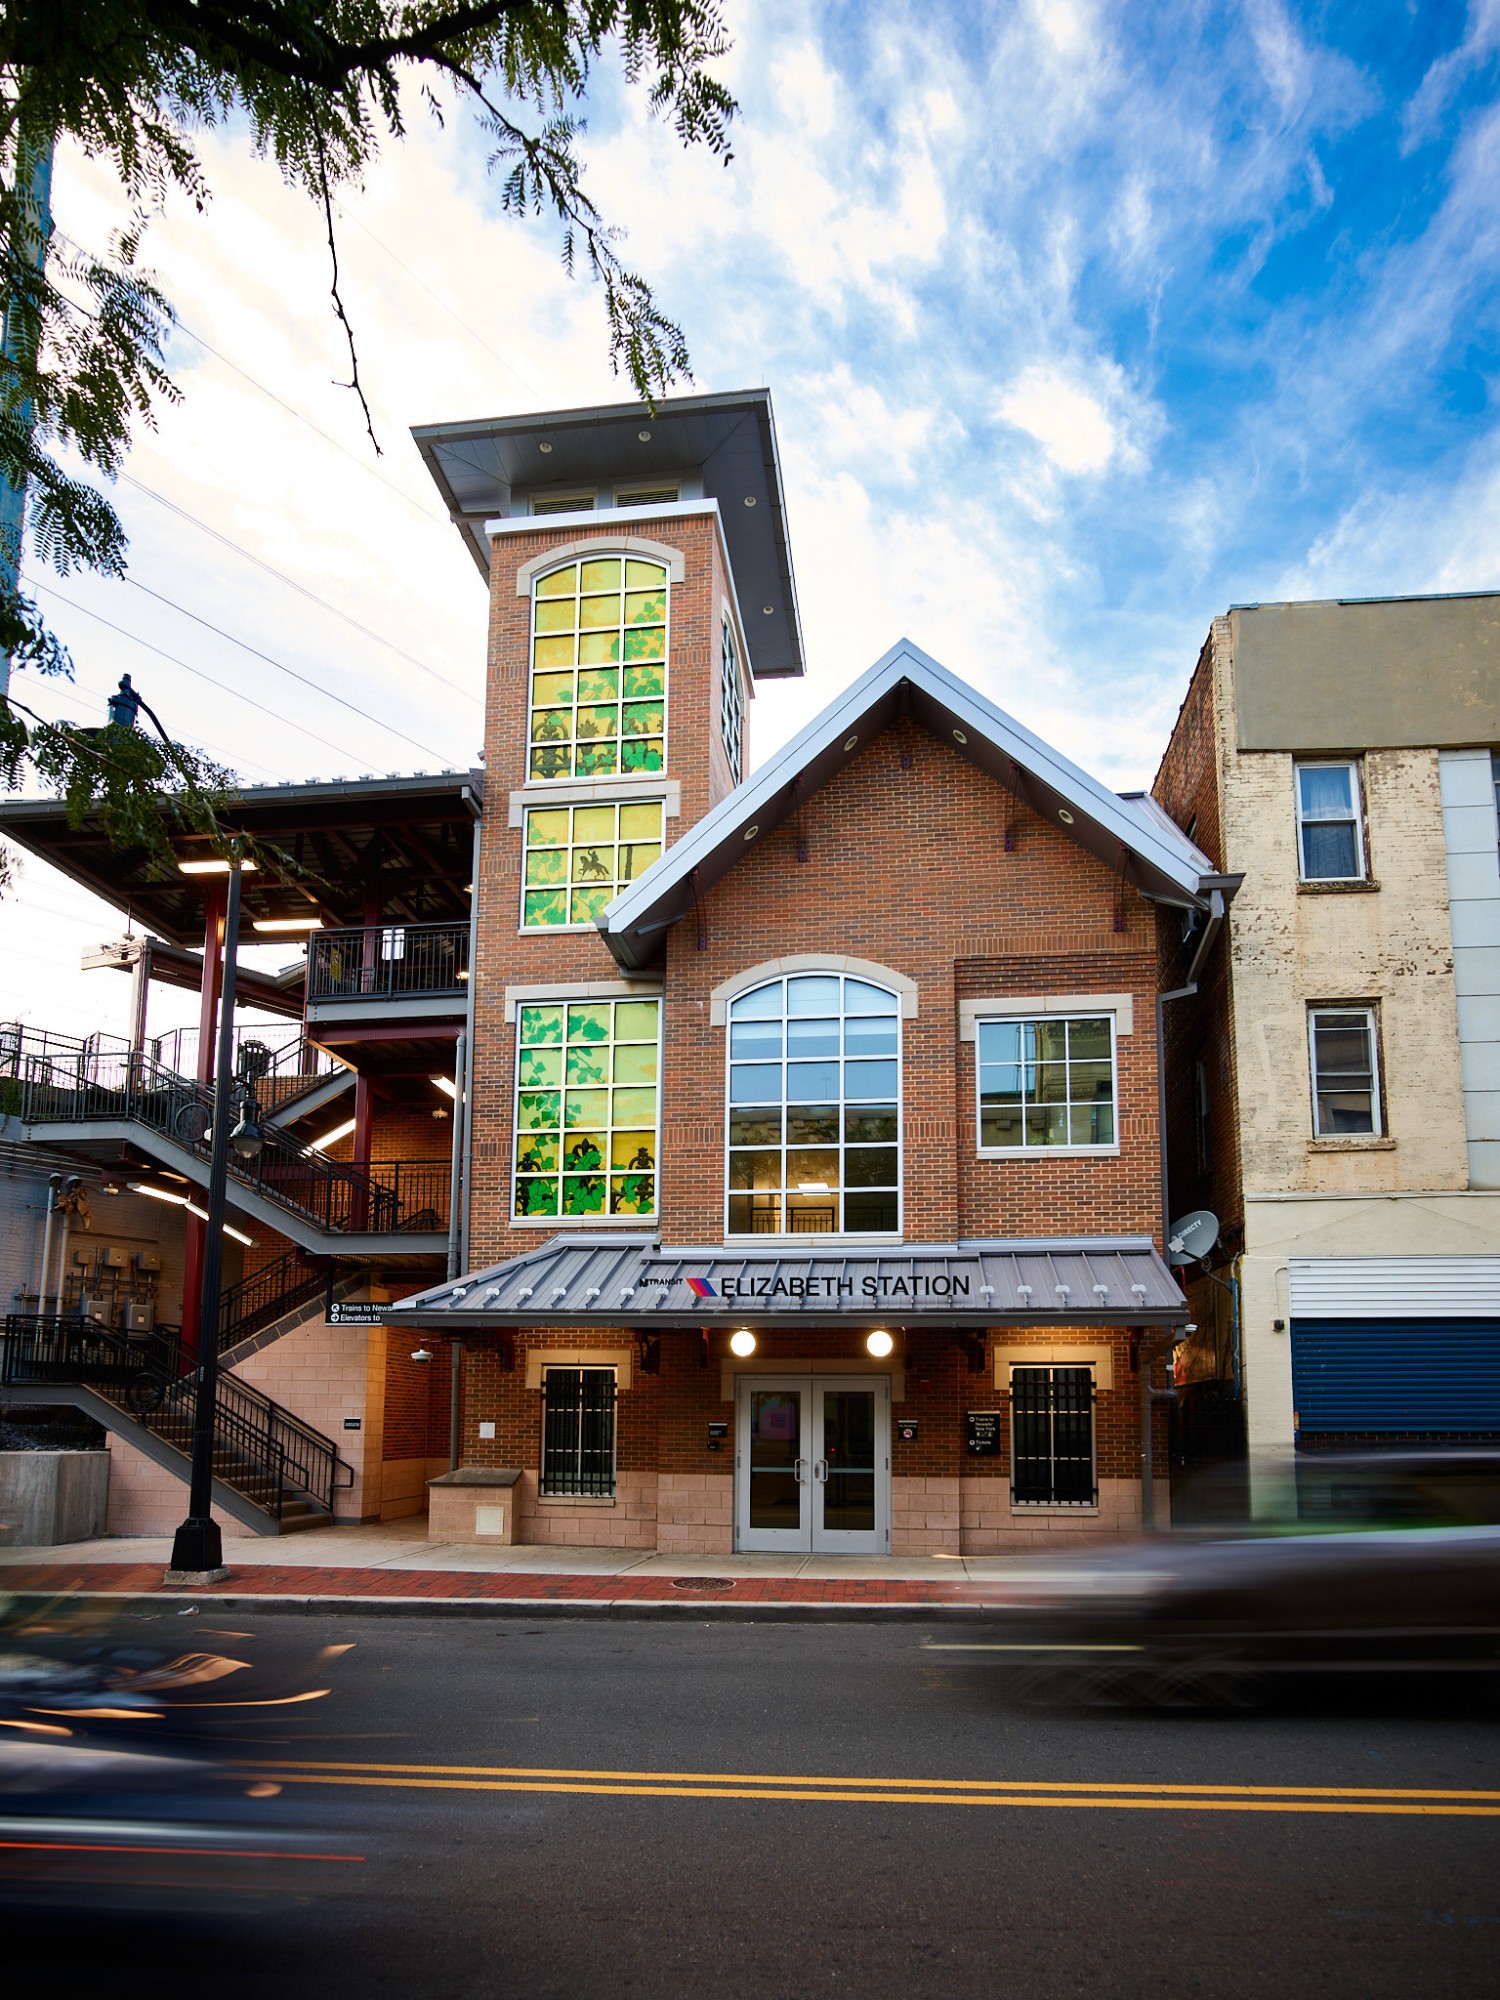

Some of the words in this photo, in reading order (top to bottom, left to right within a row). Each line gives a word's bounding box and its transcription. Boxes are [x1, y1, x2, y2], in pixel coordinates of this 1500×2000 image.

[1177, 1219, 1202, 1239] DIRECTV
[648, 1277, 683, 1285] TRANSIT
[721, 1276, 853, 1297] ELIZABETH
[861, 1275, 970, 1297] STATION
[341, 1304, 362, 1312] Trains
[363, 1304, 371, 1312] to
